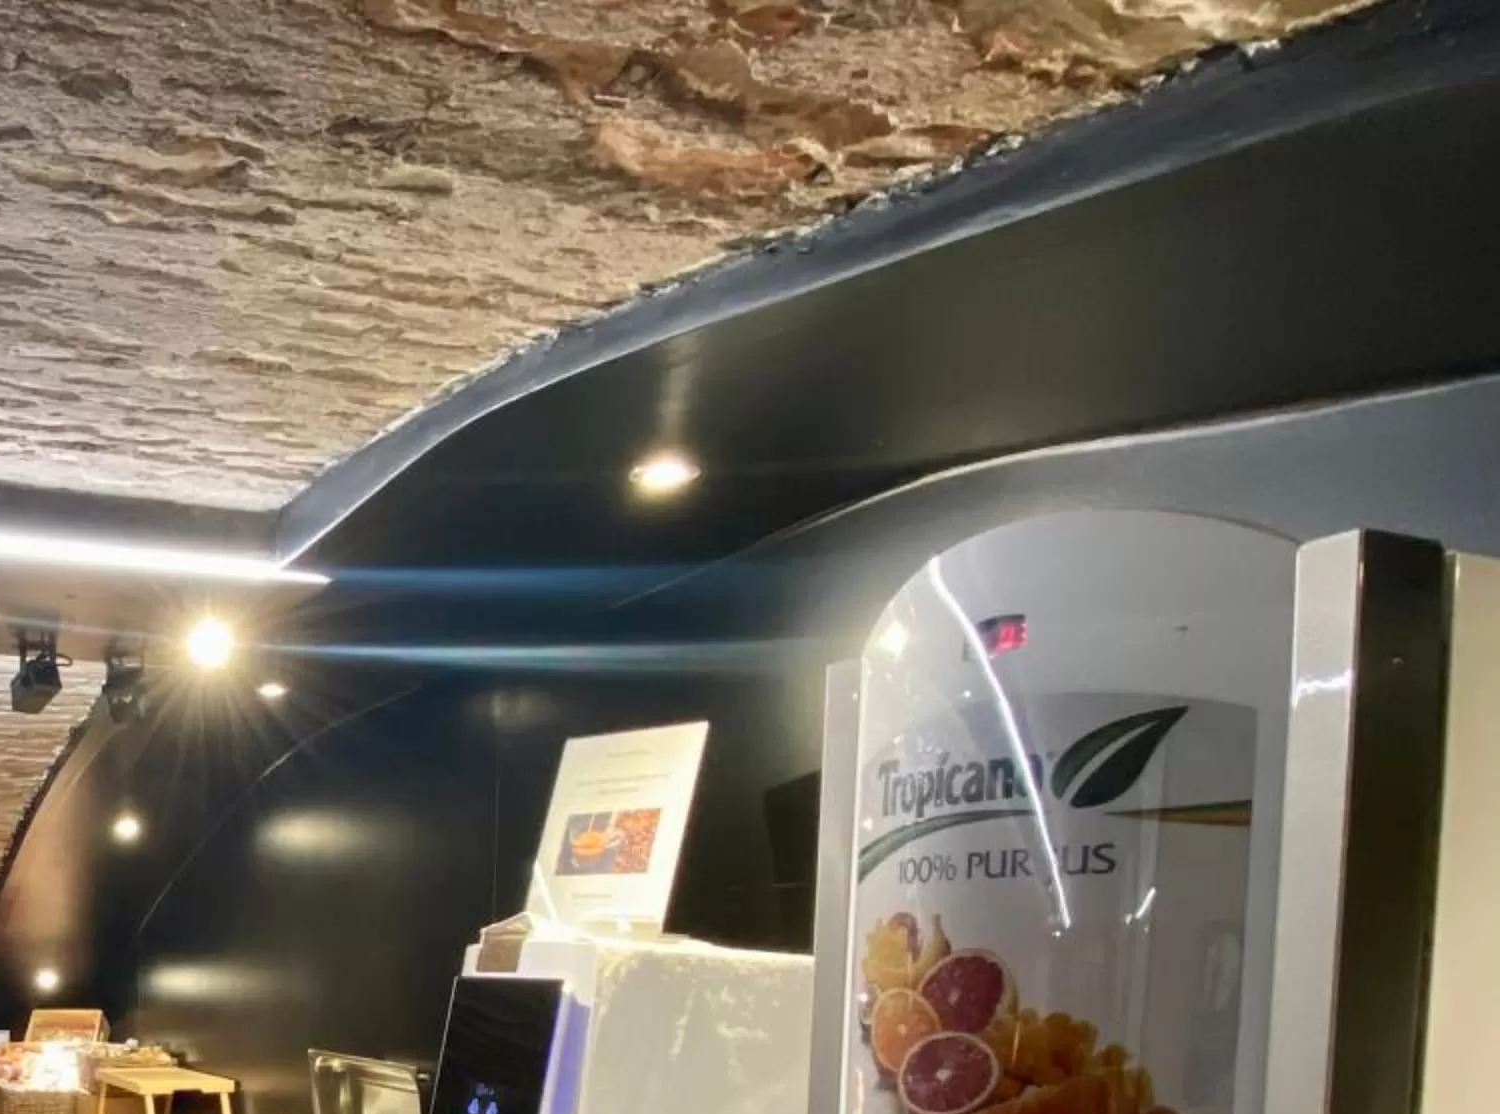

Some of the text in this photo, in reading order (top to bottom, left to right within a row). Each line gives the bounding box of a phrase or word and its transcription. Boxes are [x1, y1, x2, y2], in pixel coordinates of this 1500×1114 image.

[899, 842, 1117, 887] 100% PUR US
